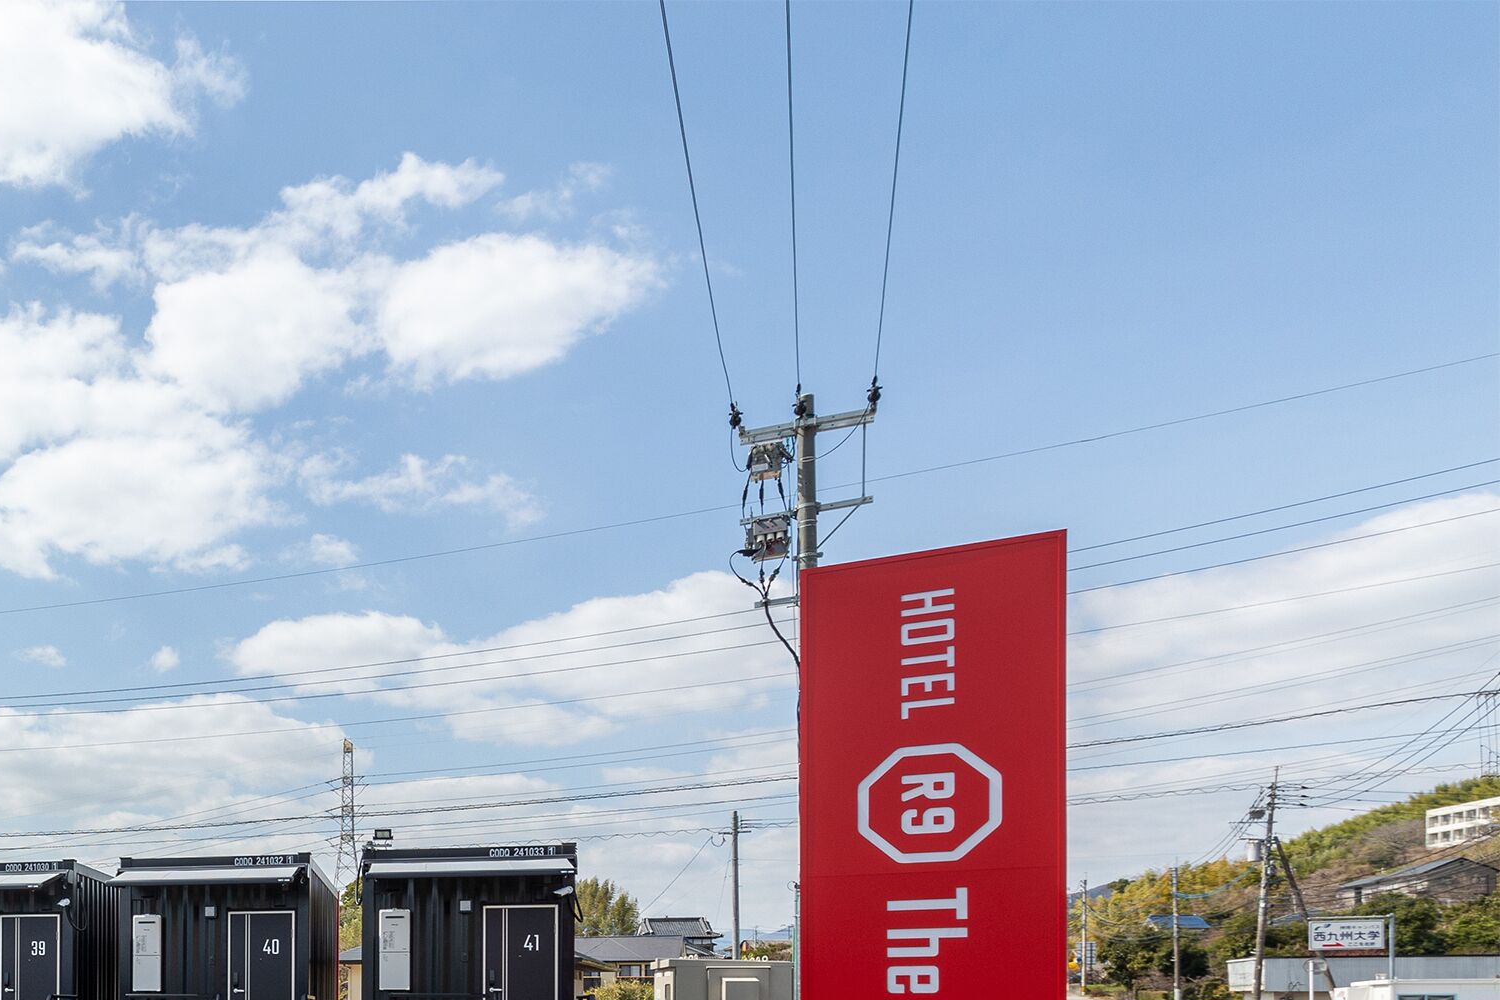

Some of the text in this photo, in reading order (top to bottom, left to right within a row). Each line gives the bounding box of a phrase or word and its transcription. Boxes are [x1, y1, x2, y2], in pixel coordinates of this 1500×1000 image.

[900, 588, 956, 720] HOTEL
[900, 771, 956, 836] R9
[513, 847, 545, 857] 241033
[24, 862, 50, 872] 241030
[256, 856, 284, 866] 241032
[523, 934, 540, 951] 41
[886, 886, 969, 994] The
[1313, 930, 1381, 942] 西九州大学
[31, 940, 46, 956] 39
[262, 938, 280, 955] 40
